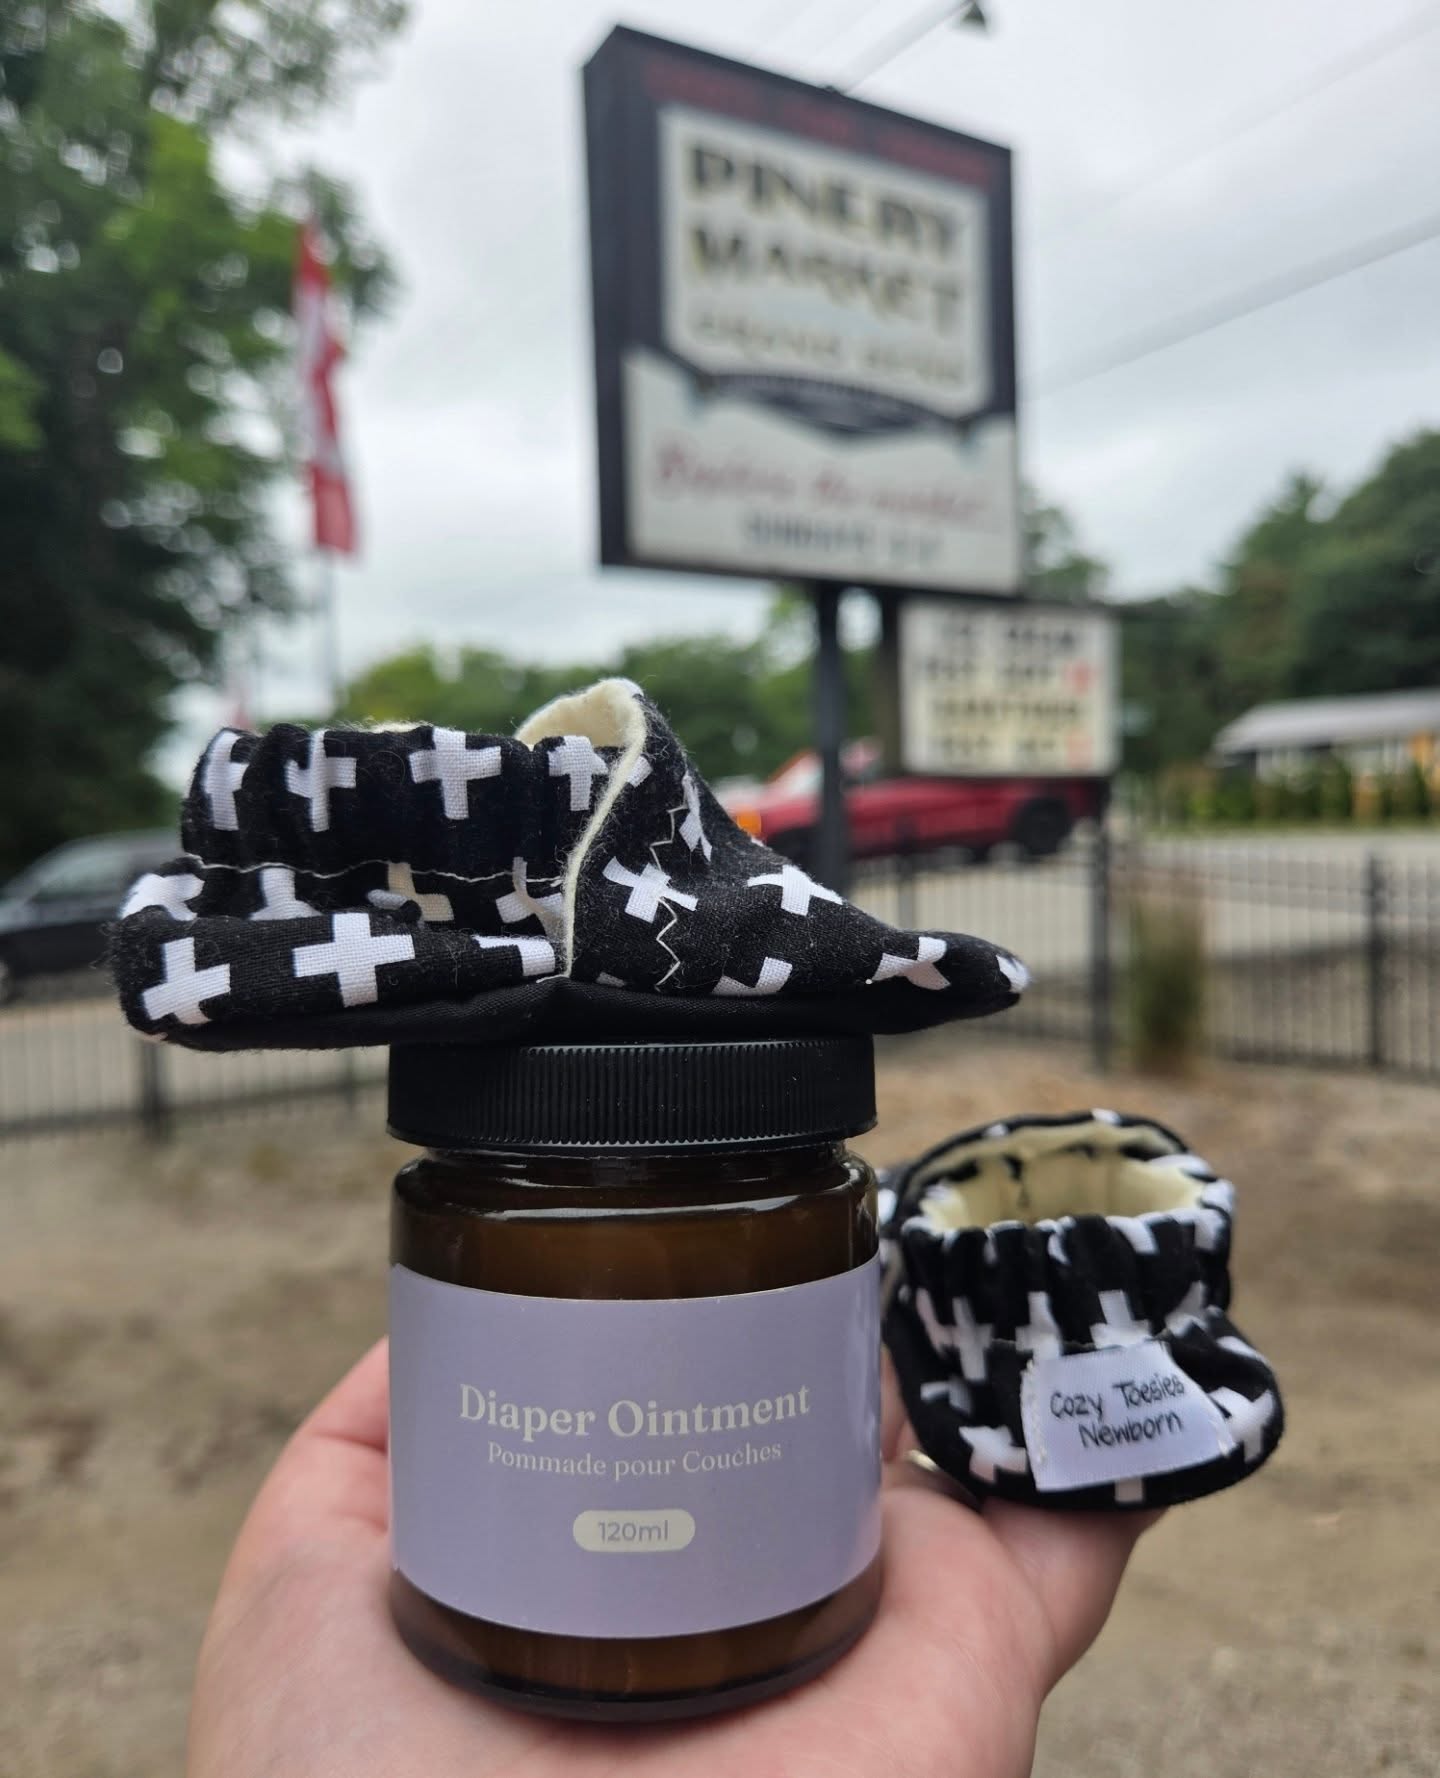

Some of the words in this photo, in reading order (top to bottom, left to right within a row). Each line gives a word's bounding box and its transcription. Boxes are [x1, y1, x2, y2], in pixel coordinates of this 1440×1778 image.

[459, 1384, 595, 1442] Diaper
[608, 1384, 811, 1437] Ointment
[1050, 1391, 1103, 1421] Cozy
[1112, 1373, 1185, 1408] Toesies
[1078, 1410, 1184, 1448] Newborn
[488, 1441, 606, 1476] Pommade
[614, 1456, 677, 1482] pour
[682, 1439, 783, 1473] Couches
[598, 1520, 669, 1543] 120ml
